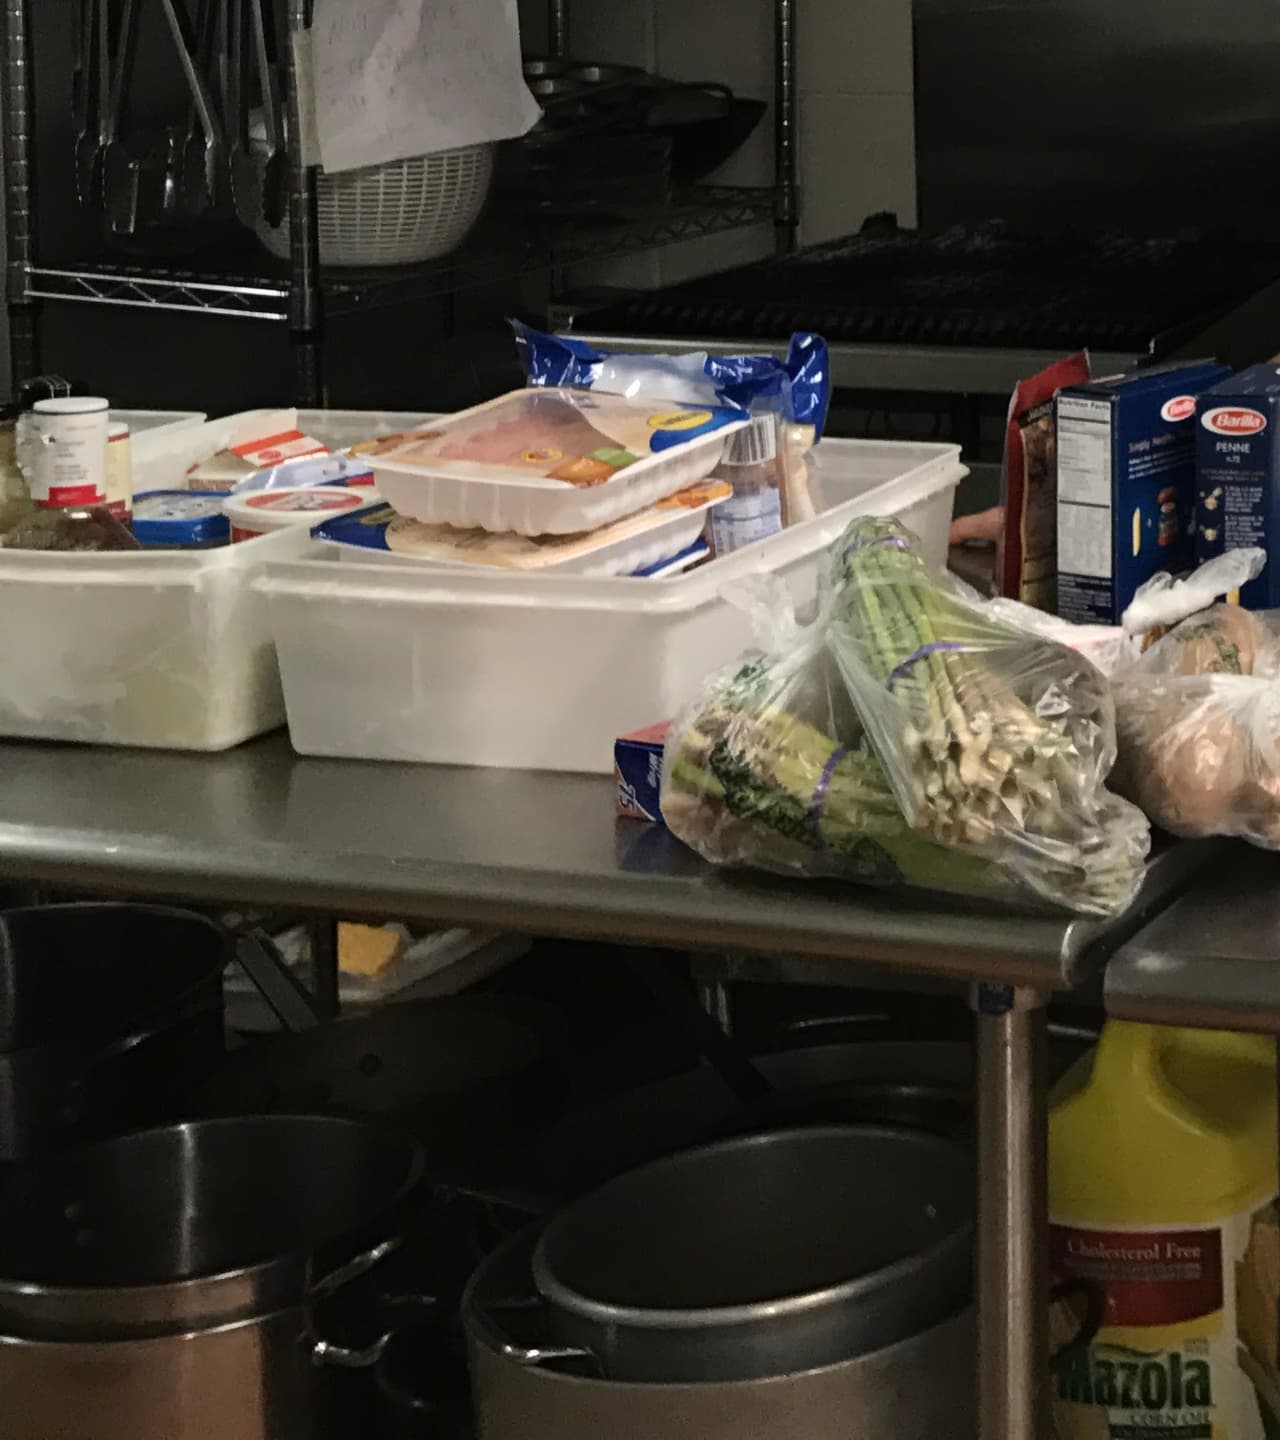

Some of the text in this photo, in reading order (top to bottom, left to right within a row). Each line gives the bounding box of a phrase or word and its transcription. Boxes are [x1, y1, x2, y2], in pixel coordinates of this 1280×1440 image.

[1215, 414, 1261, 428] Barilla
[1215, 442, 1250, 453] PENNE
[1067, 1239, 1203, 1260] Cholesterol Free
[1058, 1351, 1212, 1410] Mazola
